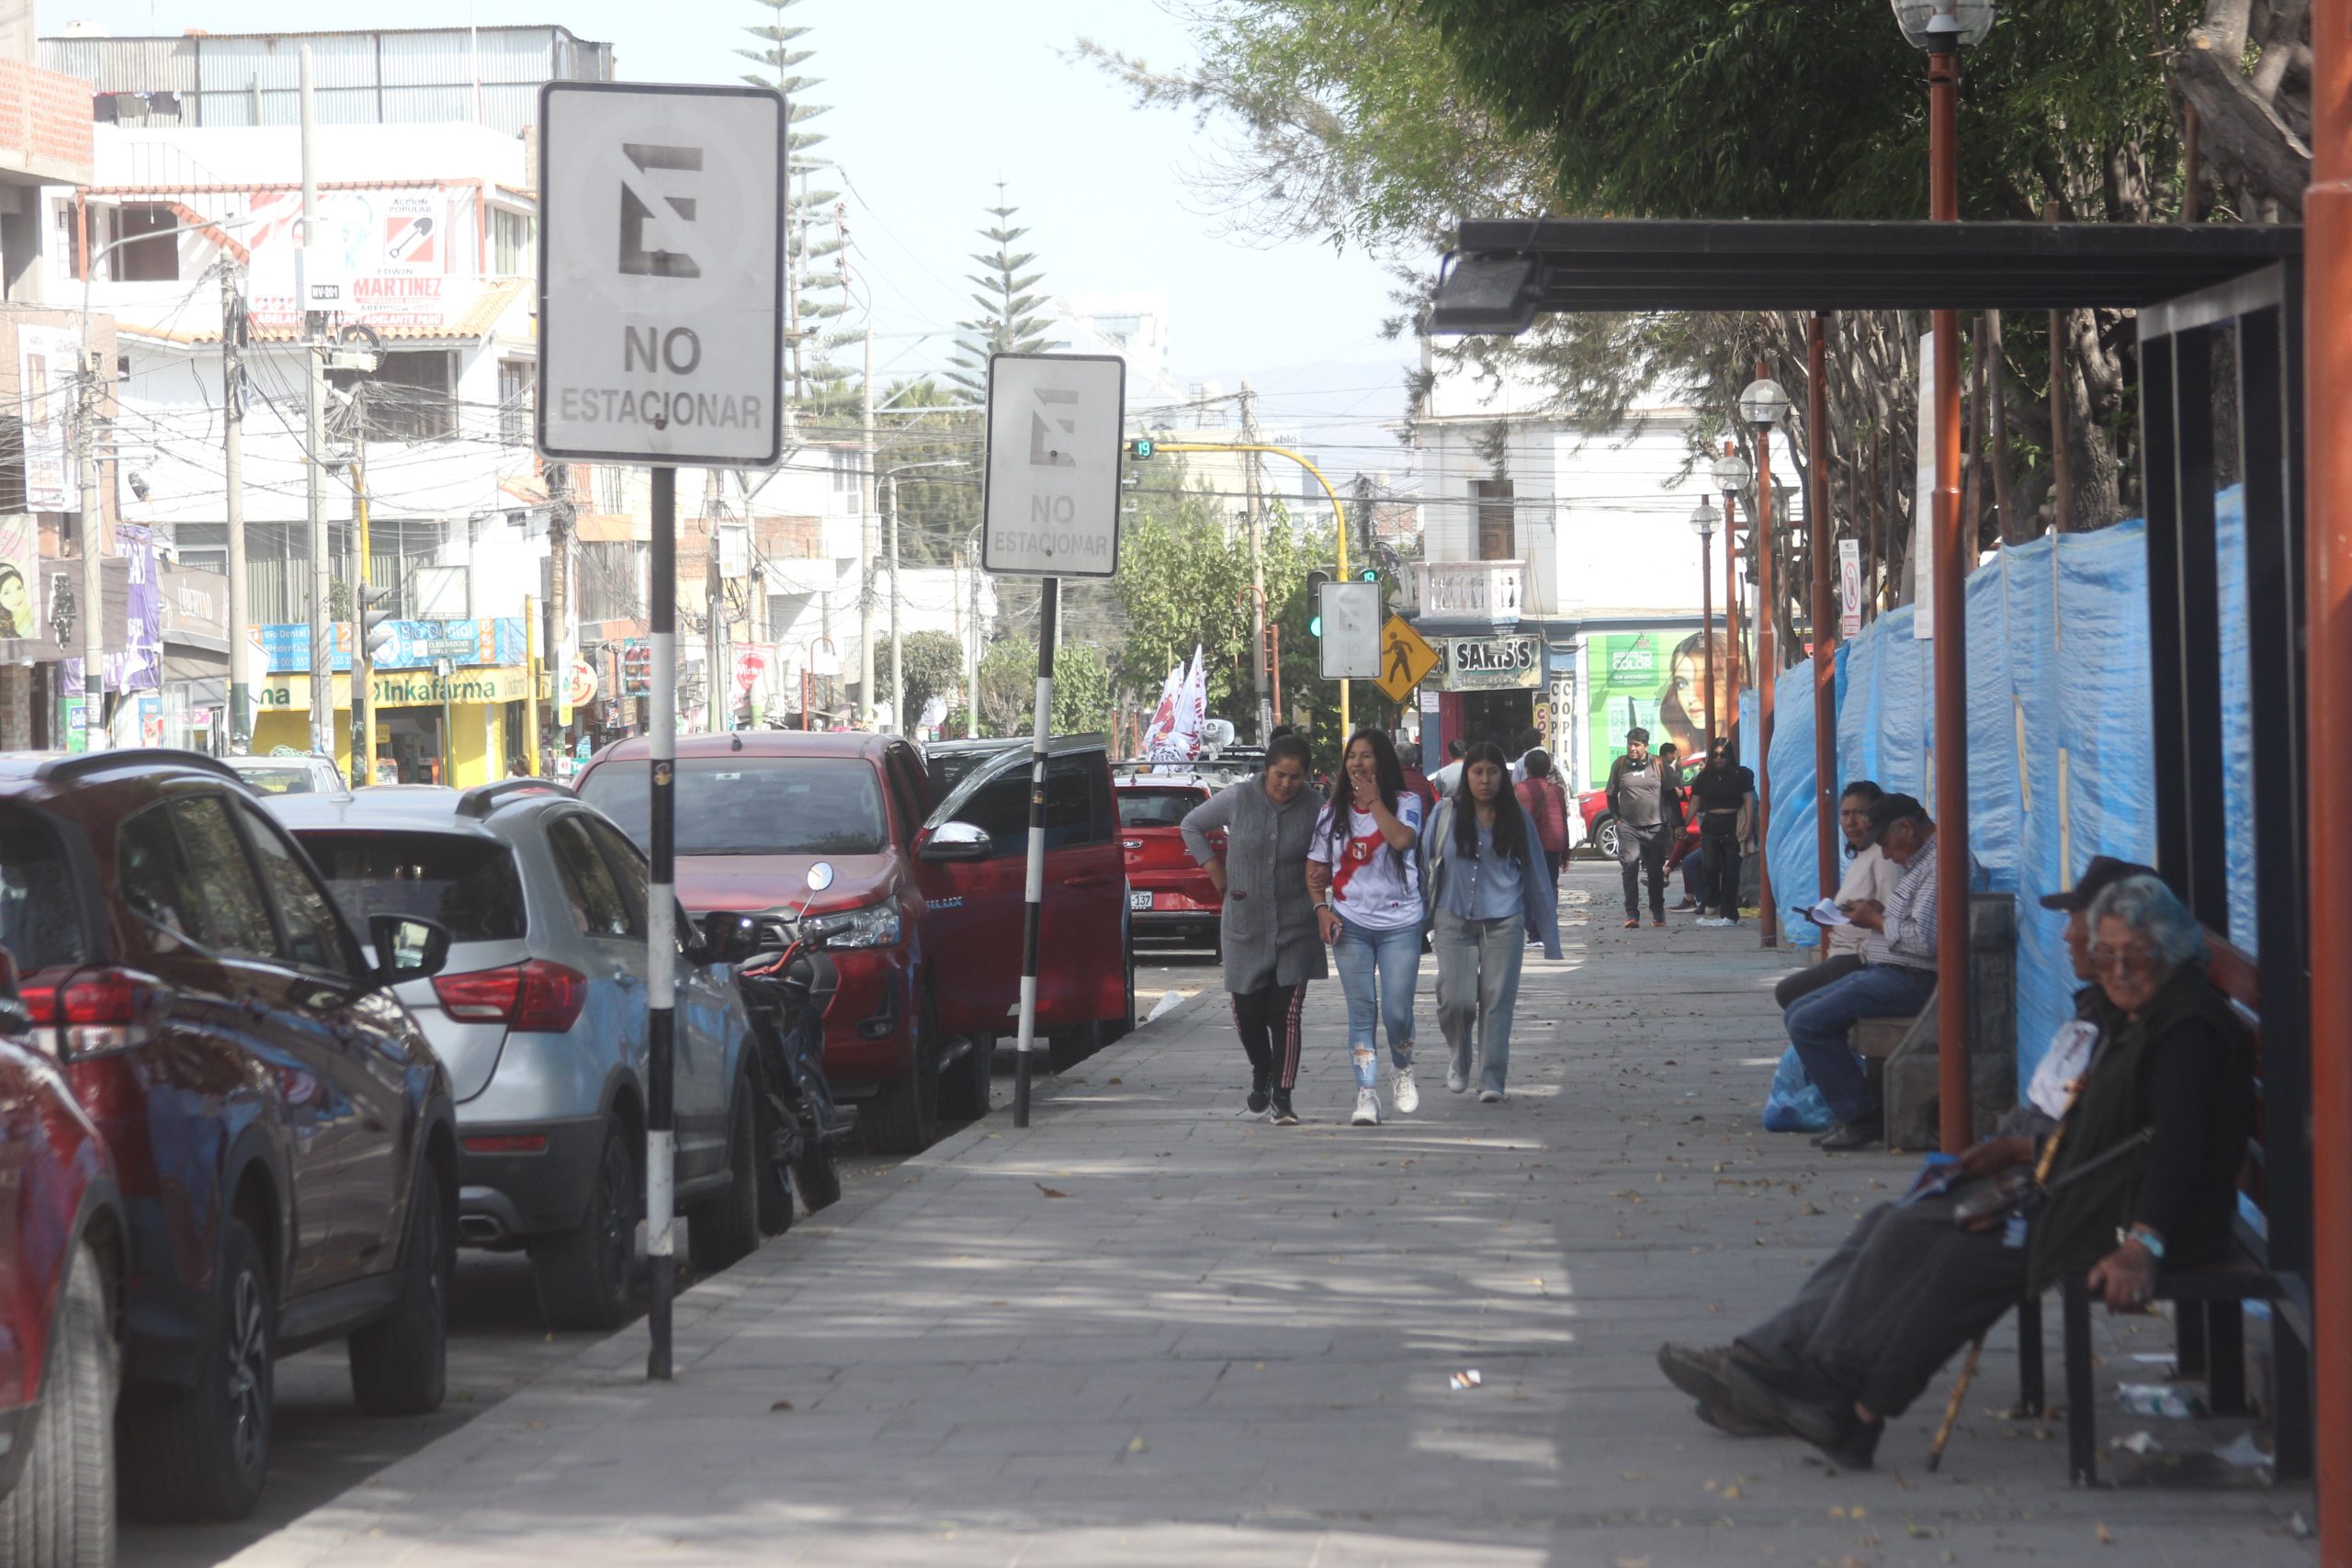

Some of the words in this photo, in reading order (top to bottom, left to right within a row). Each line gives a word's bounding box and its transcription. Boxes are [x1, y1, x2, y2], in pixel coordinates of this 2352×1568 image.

[353, 277, 442, 297] MARTINEZ
[624, 326, 701, 376] NO
[560, 388, 762, 430] ESTACIONAR
[1138, 442, 1150, 456] 19
[1030, 494, 1075, 524] NO
[994, 531, 1107, 557] ESTACIONAR
[400, 626, 425, 639] Bio
[1612, 660, 1652, 671] COLOR
[383, 679, 495, 702] Inkafarma
